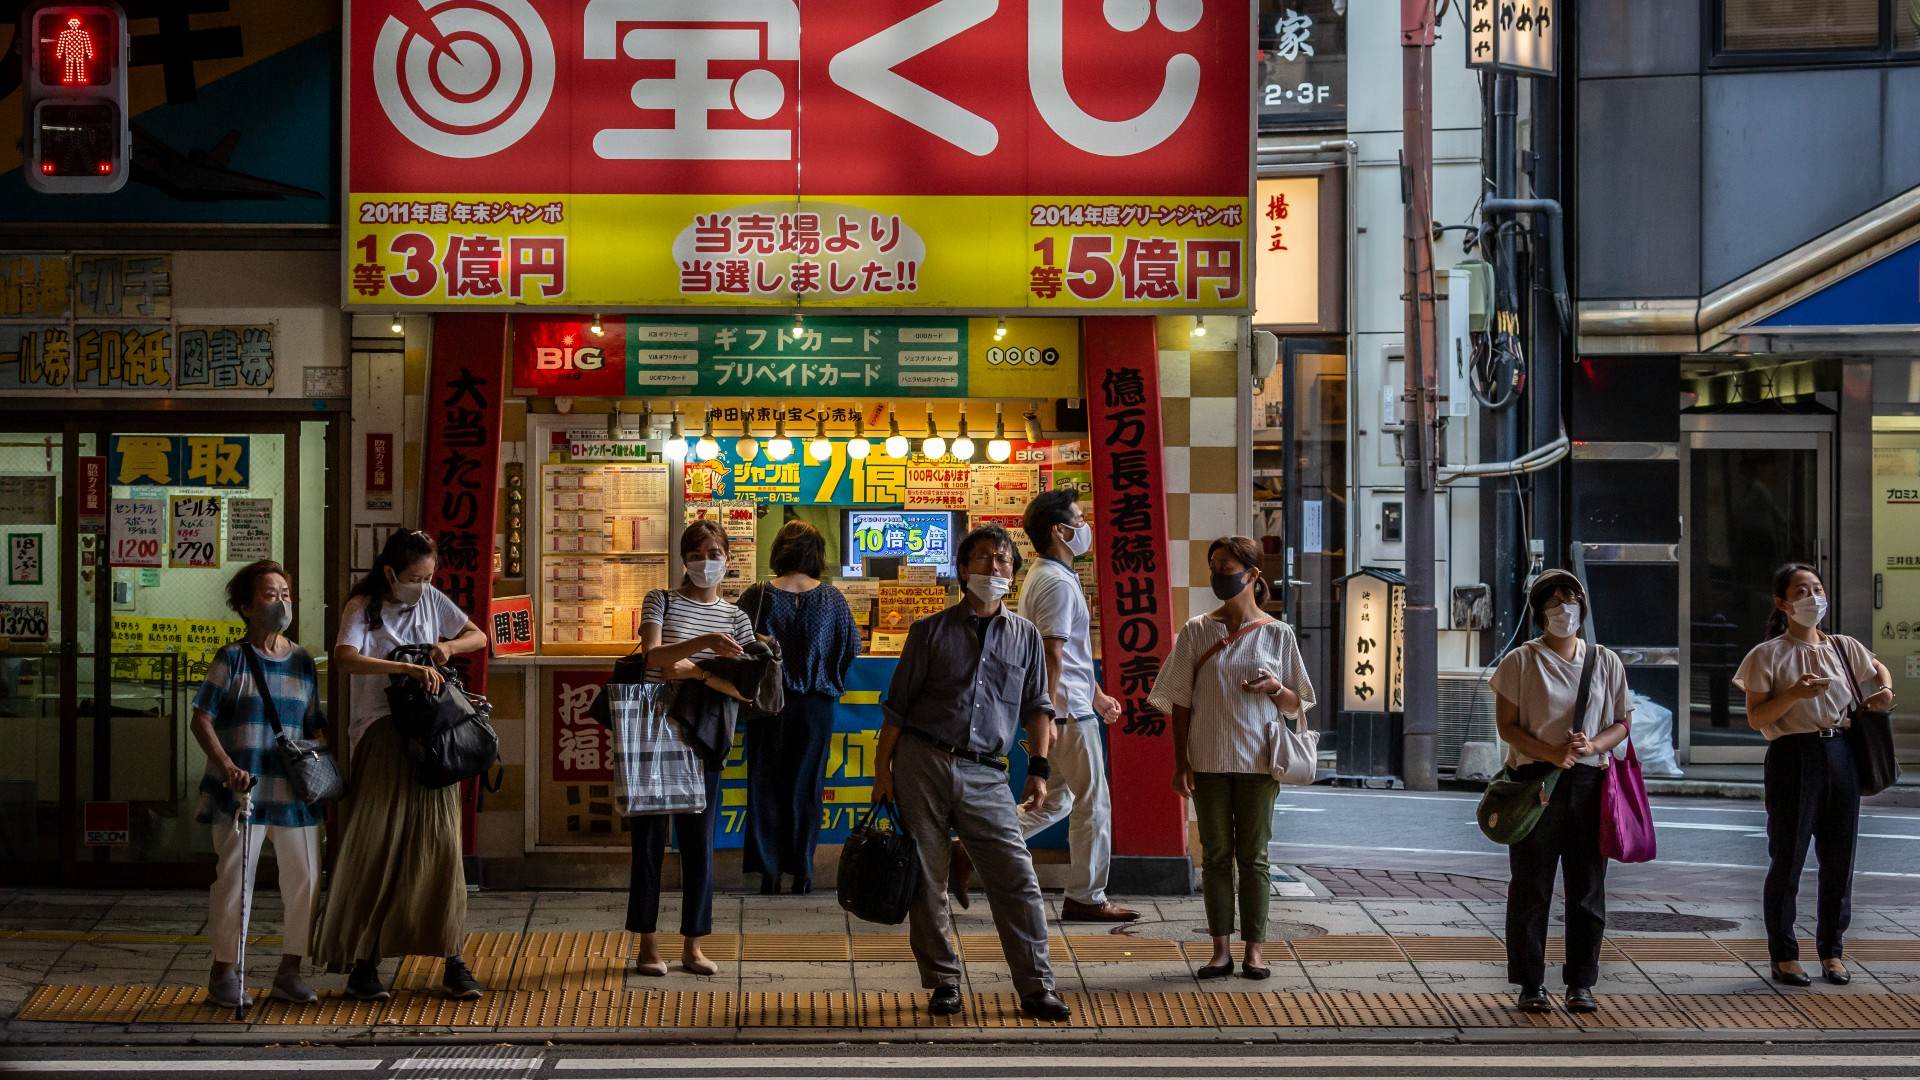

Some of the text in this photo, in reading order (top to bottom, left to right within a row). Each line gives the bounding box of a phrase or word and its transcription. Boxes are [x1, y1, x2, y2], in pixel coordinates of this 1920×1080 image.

[1500, 2, 1550, 37] かめや
[360, 201, 564, 223] 2011年度 年末ジャンボ
[1031, 204, 1244, 227] 2014年度グリーンジャンボ
[694, 213, 902, 255] 当売場より
[388, 230, 566, 298] 3億円
[1066, 235, 1242, 300] 5億円
[714, 327, 882, 351] ギフトカード
[77, 329, 171, 385] 印紙
[178, 329, 273, 386] 図書券
[537, 347, 604, 370] BIG
[988, 348, 1058, 364] toto
[713, 364, 881, 387] プリペイドカード
[117, 436, 243, 485] 買取
[1016, 450, 1045, 461] BIG
[734, 463, 800, 483] ジャンボ
[908, 469, 970, 482] 100円くじあります
[909, 496, 965, 504] スクラッチ発売中
[1886, 490, 1918, 499] プロミス
[117, 540, 158, 558] 1200
[1101, 368, 1166, 737] 億万長者続出の売場
[1355, 636, 1376, 701] かめや
